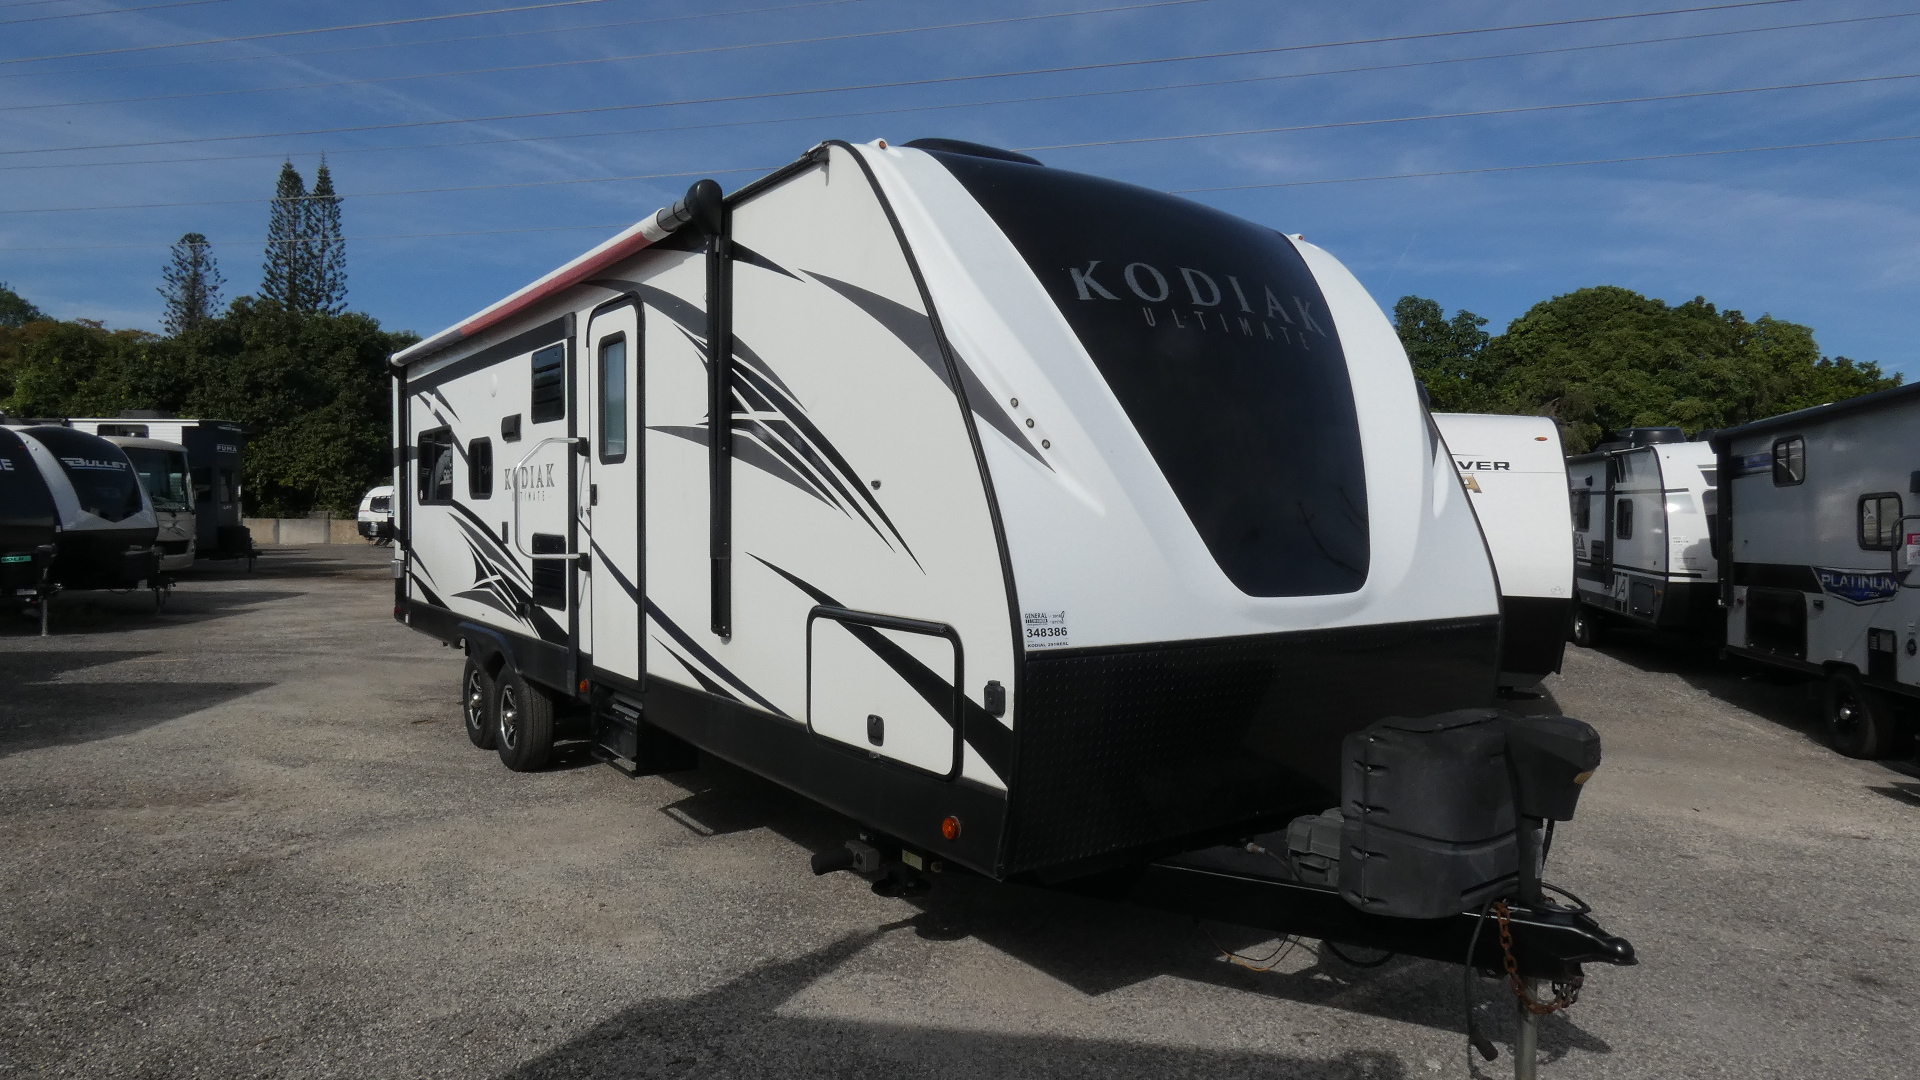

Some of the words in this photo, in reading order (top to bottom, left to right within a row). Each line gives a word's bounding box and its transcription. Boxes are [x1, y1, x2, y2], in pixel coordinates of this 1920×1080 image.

[1069, 260, 1327, 338] KODIAK
[1142, 307, 1310, 350] ULTIMATE
[216, 443, 237, 453] PUMA
[60, 457, 127, 470] BULLET
[1821, 573, 1899, 591] PLATINUM
[1026, 626, 1068, 638] 348386
